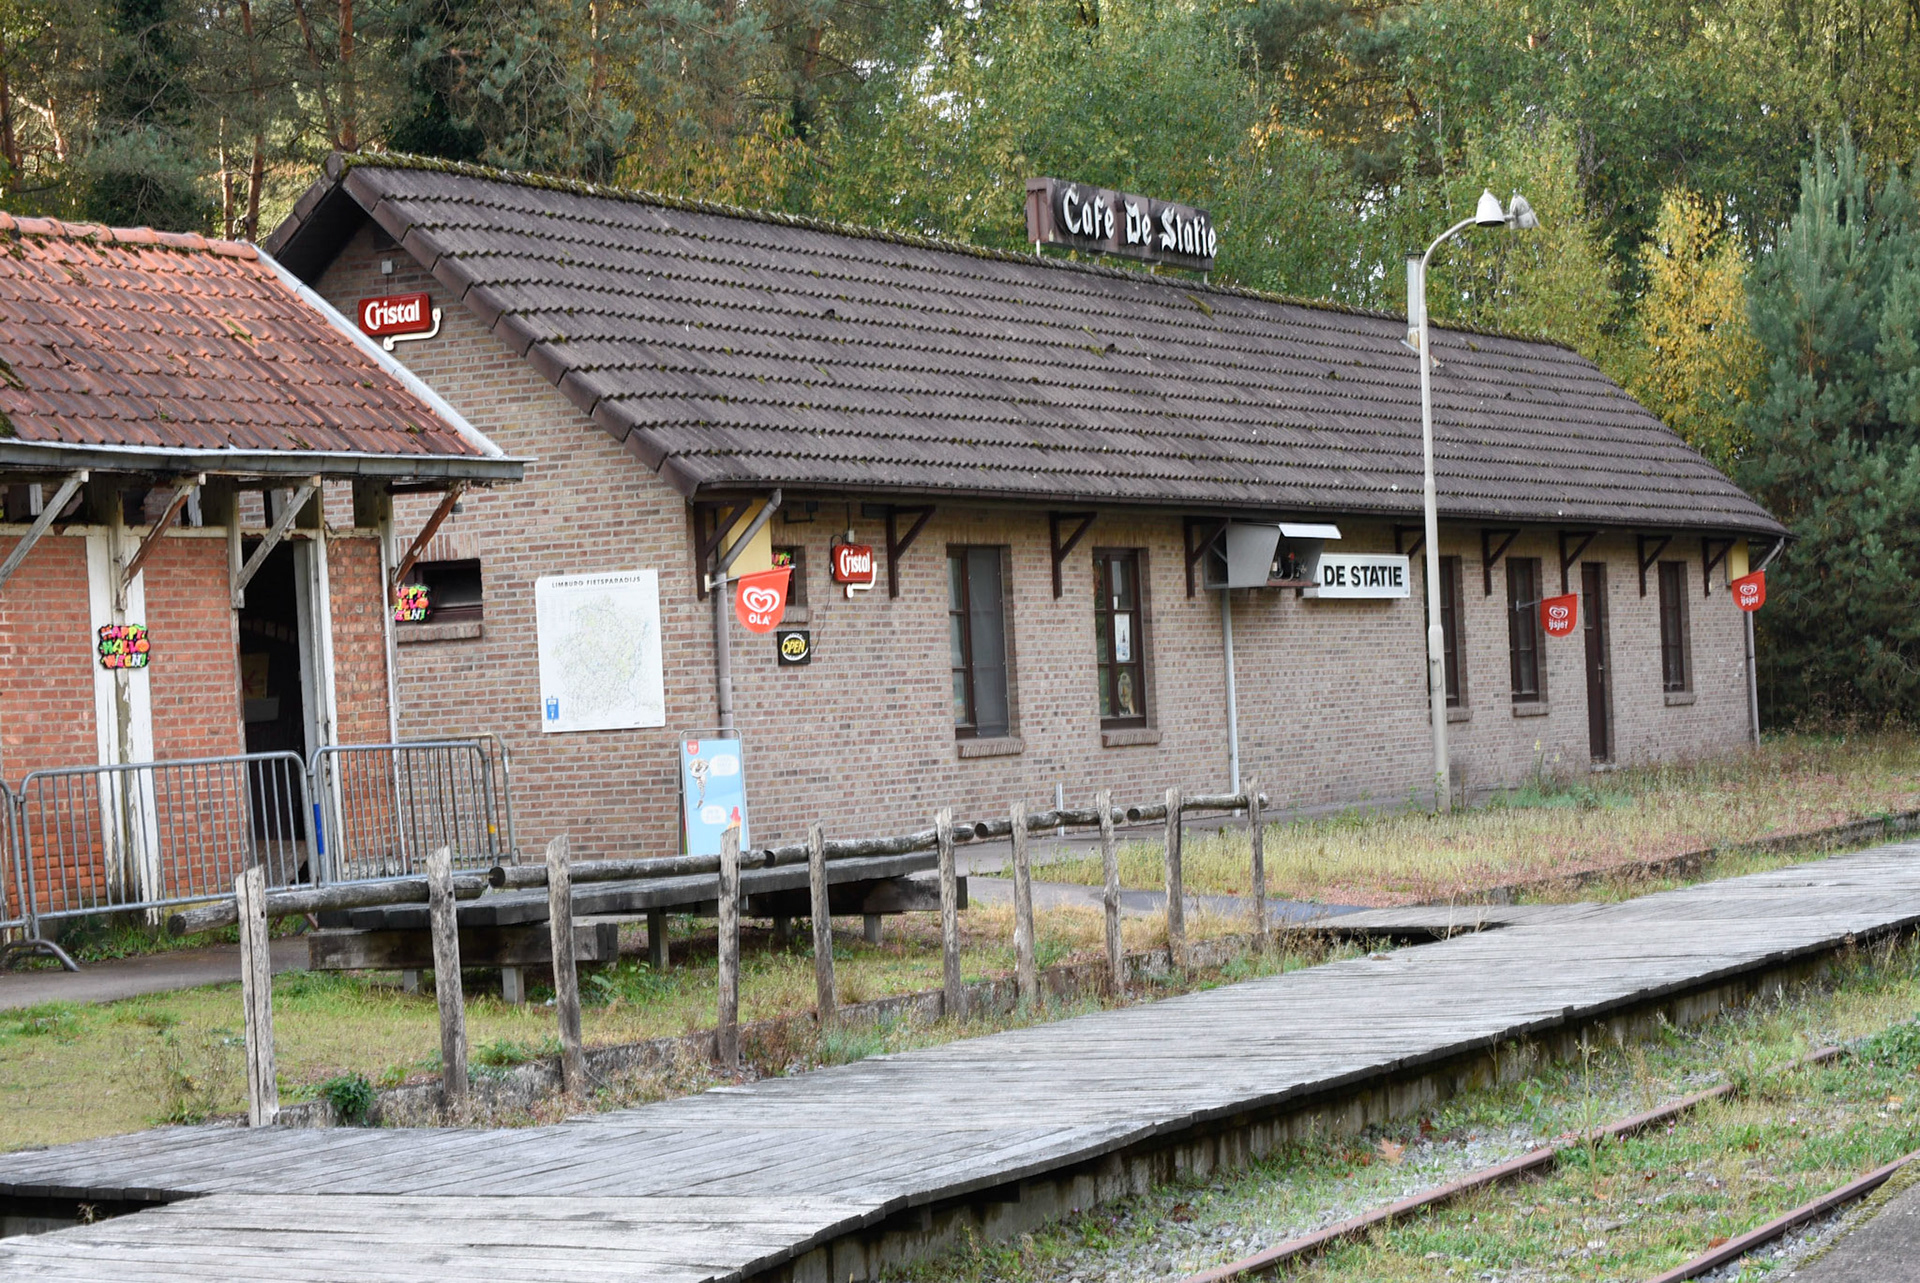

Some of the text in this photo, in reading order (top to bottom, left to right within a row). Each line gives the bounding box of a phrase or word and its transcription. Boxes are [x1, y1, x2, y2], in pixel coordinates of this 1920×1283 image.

[1124, 200, 1152, 246] De
[1159, 205, 1218, 259] Statie
[364, 299, 421, 331] Cristal
[840, 548, 871, 577] Cristal
[551, 581, 584, 589] LIMBURG
[586, 576, 641, 586] FIETSPARADIJS
[1323, 565, 1403, 588] DE STATIE
[748, 613, 770, 625] OLA
[781, 639, 807, 654] OPEN
